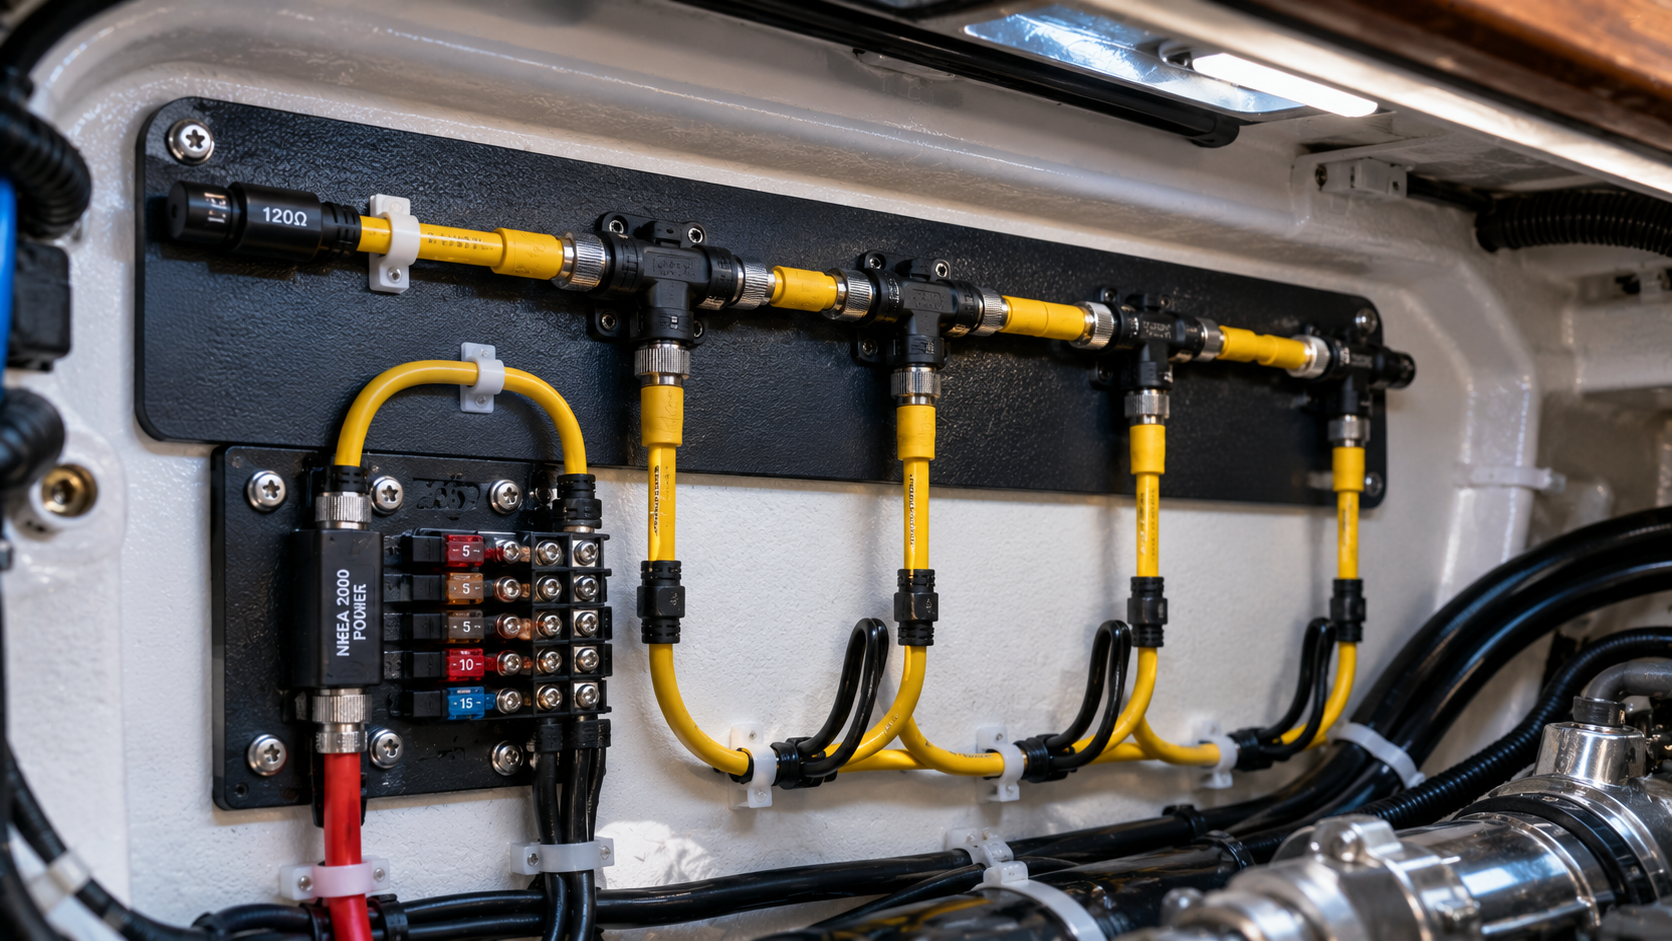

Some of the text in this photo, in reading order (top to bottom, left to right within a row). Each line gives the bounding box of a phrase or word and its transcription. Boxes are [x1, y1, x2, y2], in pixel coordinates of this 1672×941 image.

[263, 206, 307, 227] 120Ω
[462, 545, 470, 557] 5
[336, 569, 350, 606] 2000
[462, 621, 471, 633] 5
[459, 659, 474, 671] 10
[459, 697, 473, 709] 15
